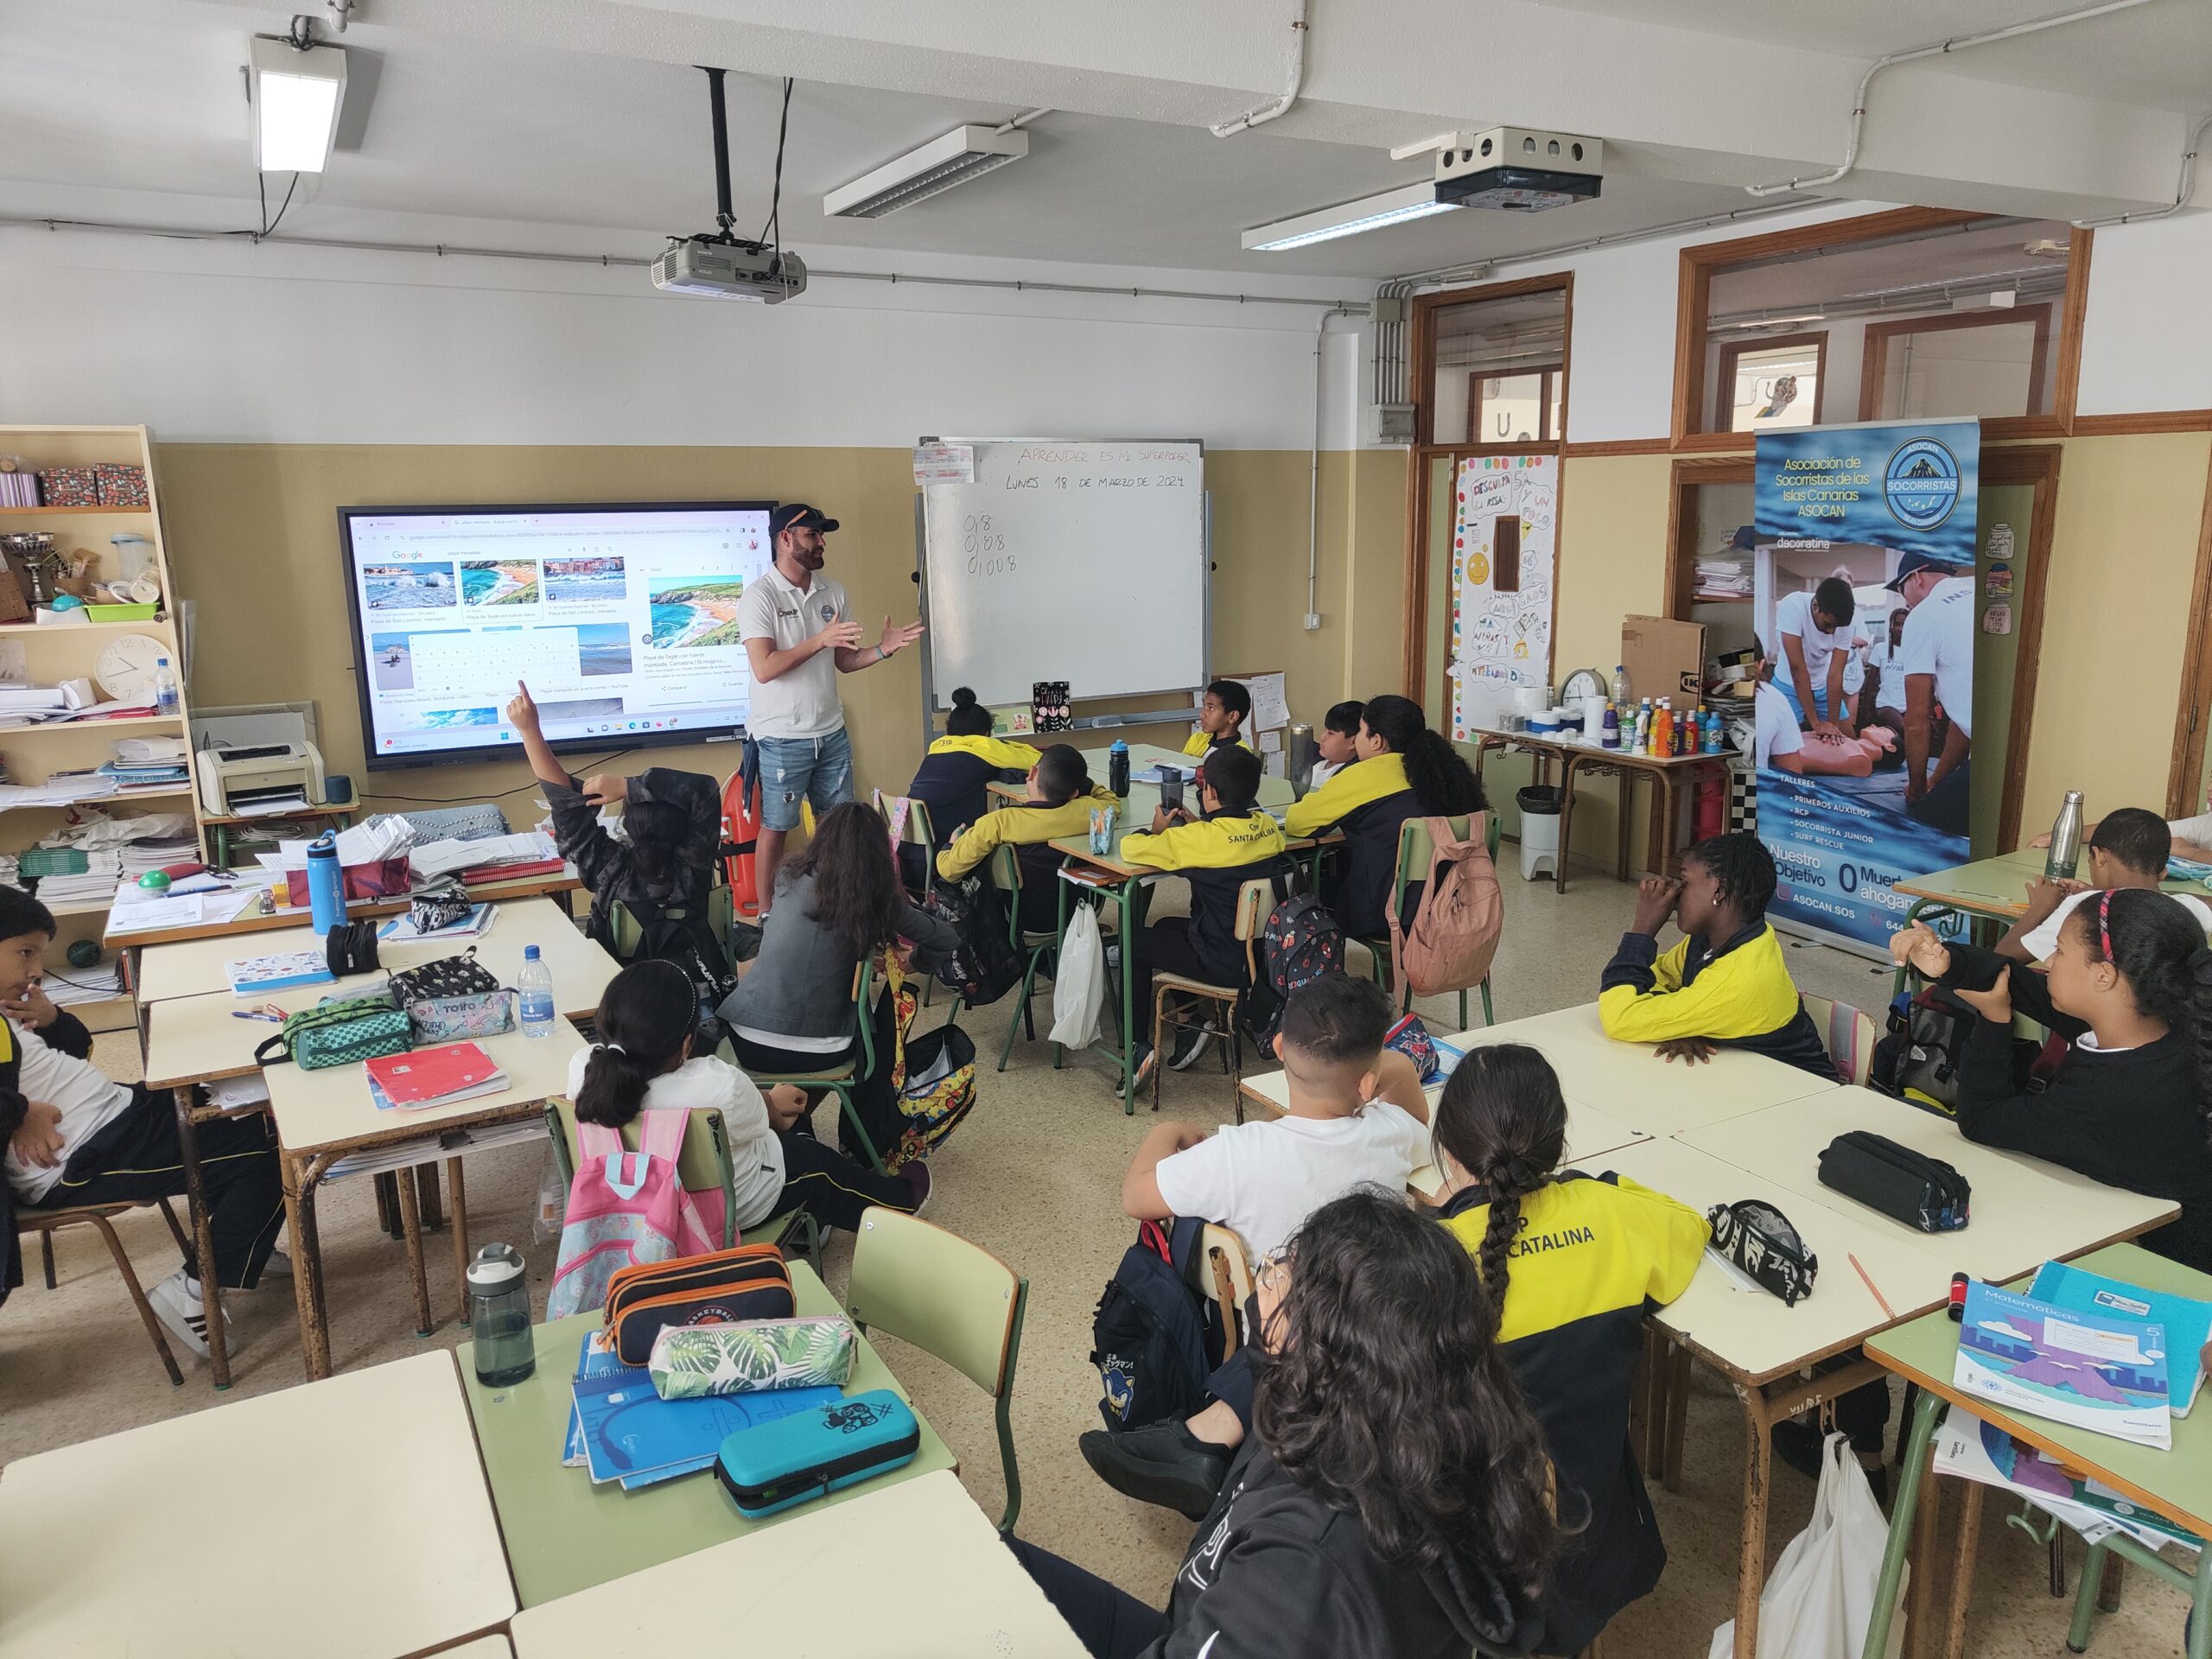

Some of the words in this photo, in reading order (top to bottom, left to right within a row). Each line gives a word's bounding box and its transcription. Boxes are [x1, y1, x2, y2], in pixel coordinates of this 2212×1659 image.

[1020, 448, 1088, 463] APRENDER
[1099, 449, 1113, 461] ES
[1907, 442, 1939, 454] ASOCAN
[1784, 456, 1843, 471] Asociación
[1846, 456, 1861, 469] de
[1006, 474, 1038, 490] LUNES
[1054, 476, 1067, 489] 18
[1079, 478, 1090, 487] DE
[1098, 476, 1135, 487] MARZO
[1136, 477, 1150, 486] DE
[1776, 473, 1834, 486] Socorristas
[1836, 473, 1852, 485] de
[1853, 472, 1870, 485] las
[1887, 480, 1956, 492] SOCORRISTAS
[1783, 489, 1805, 502] Islas
[1808, 488, 1859, 502] Canarias
[1798, 505, 1846, 518] ASOCAN
[1777, 537, 1829, 550] decoratina
[392, 550, 423, 566] Google
[1780, 775, 1815, 788] TALLERES
[1795, 795, 1831, 810] PRIMEROS
[1833, 804, 1871, 817] AUXILIOS
[1795, 807, 1809, 817] RCP
[1228, 832, 1254, 843] SANTA
[1795, 820, 1841, 837] SOCORRISTA
[1843, 831, 1873, 844] JUNIOR
[1795, 831, 1813, 842] SURF
[1815, 836, 1845, 849] RESCUE
[1770, 843, 1821, 869] Nuestro
[1776, 861, 1826, 887] Objetivo
[1839, 862, 1857, 893] 0
[1793, 893, 1855, 919] ASOCAN.SOS
[1507, 1226, 1595, 1258] CATALINA
[2146, 1326, 2160, 1337] 5
